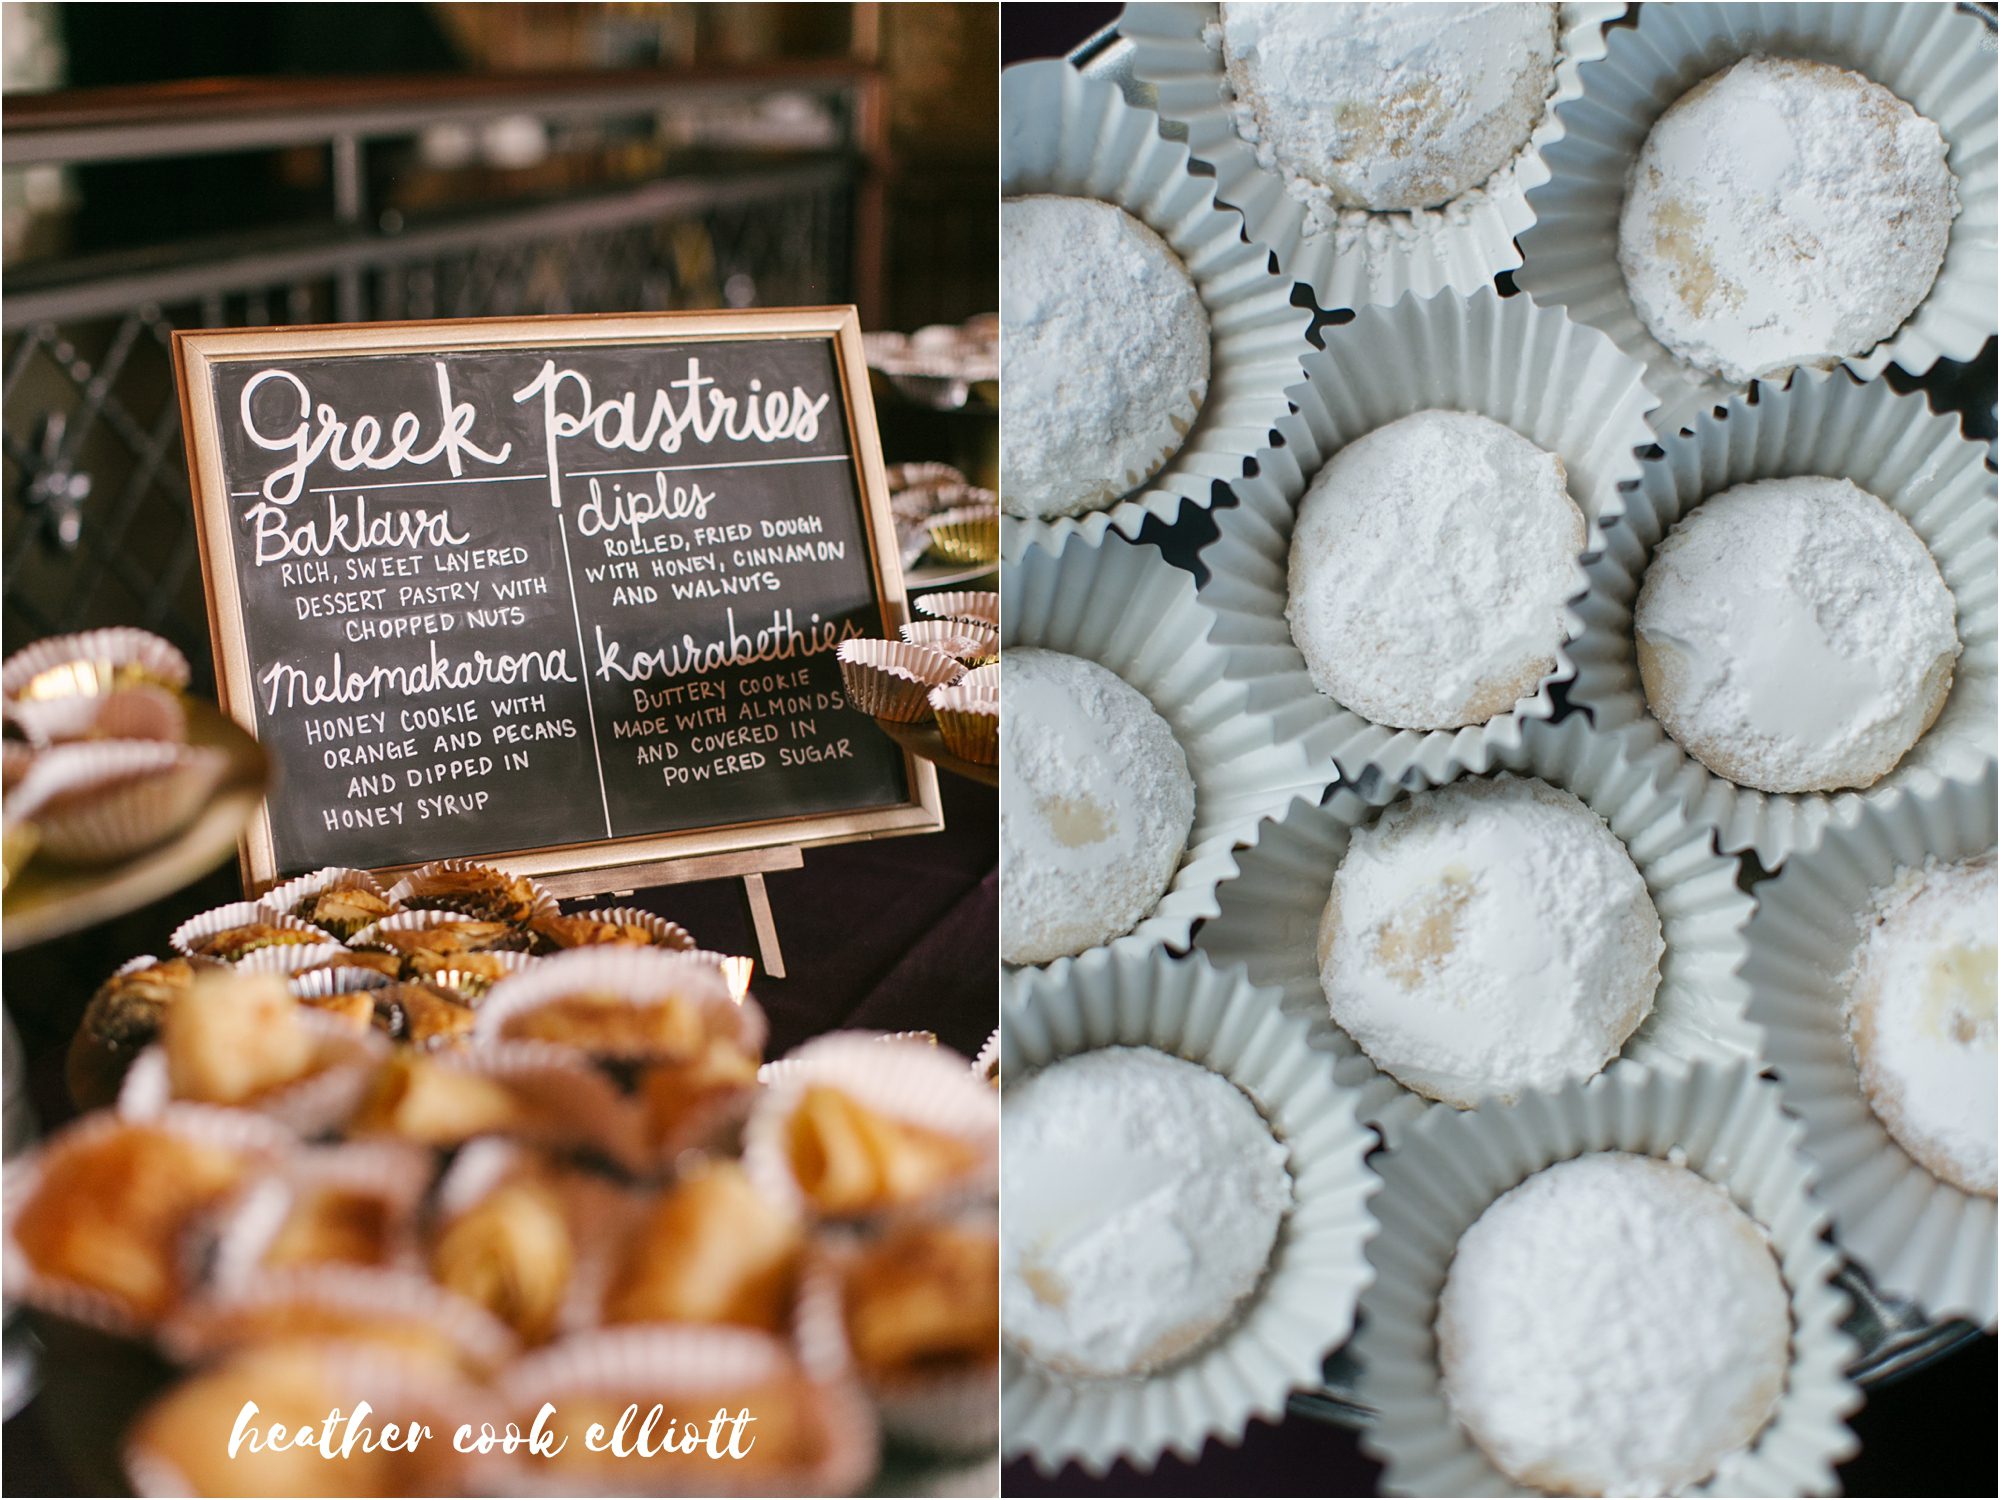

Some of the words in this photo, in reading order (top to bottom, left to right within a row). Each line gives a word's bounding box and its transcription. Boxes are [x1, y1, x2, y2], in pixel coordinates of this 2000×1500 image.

[240, 361, 512, 505] Greek
[513, 357, 830, 508] Pastries
[244, 494, 470, 567] Baklava
[577, 471, 716, 546] diples
[604, 533, 690, 558] ROLLED,
[694, 523, 752, 546] FRIED
[760, 515, 823, 538] DOUGH
[281, 562, 337, 587] RICH,
[346, 555, 423, 582] SWEET
[434, 547, 529, 572] LAYERED
[585, 562, 640, 583] WITH
[653, 553, 725, 578] HONEY,
[733, 541, 845, 567] CINNAMON
[296, 588, 386, 620] DESSERT
[400, 581, 480, 607] PASTRY
[493, 576, 547, 601] WITH
[612, 586, 658, 607] AND
[672, 571, 781, 601] WALNUTS
[346, 612, 455, 642] CHOPPED
[468, 606, 525, 628] NUTS
[633, 680, 727, 713] BUTTERY
[739, 668, 810, 696] COOKIE
[305, 711, 385, 745] HONEY
[400, 700, 478, 732] COOKIE
[491, 694, 546, 718] WITH
[613, 717, 669, 739] MADE
[675, 705, 727, 732] WITH
[739, 690, 844, 720] ALMONDS
[323, 738, 418, 769] ORANGE
[434, 730, 482, 752] AND
[493, 718, 577, 744] PECANS
[636, 742, 678, 765] AND
[691, 724, 779, 754] COVERED
[791, 719, 817, 739] IN
[663, 752, 766, 786] POWERED
[779, 738, 853, 766] SUGAR
[347, 774, 396, 798] AND
[407, 756, 492, 787] DIPPED
[504, 750, 529, 771] IN
[322, 802, 403, 831] HONEY
[417, 791, 489, 820] SYRUP
